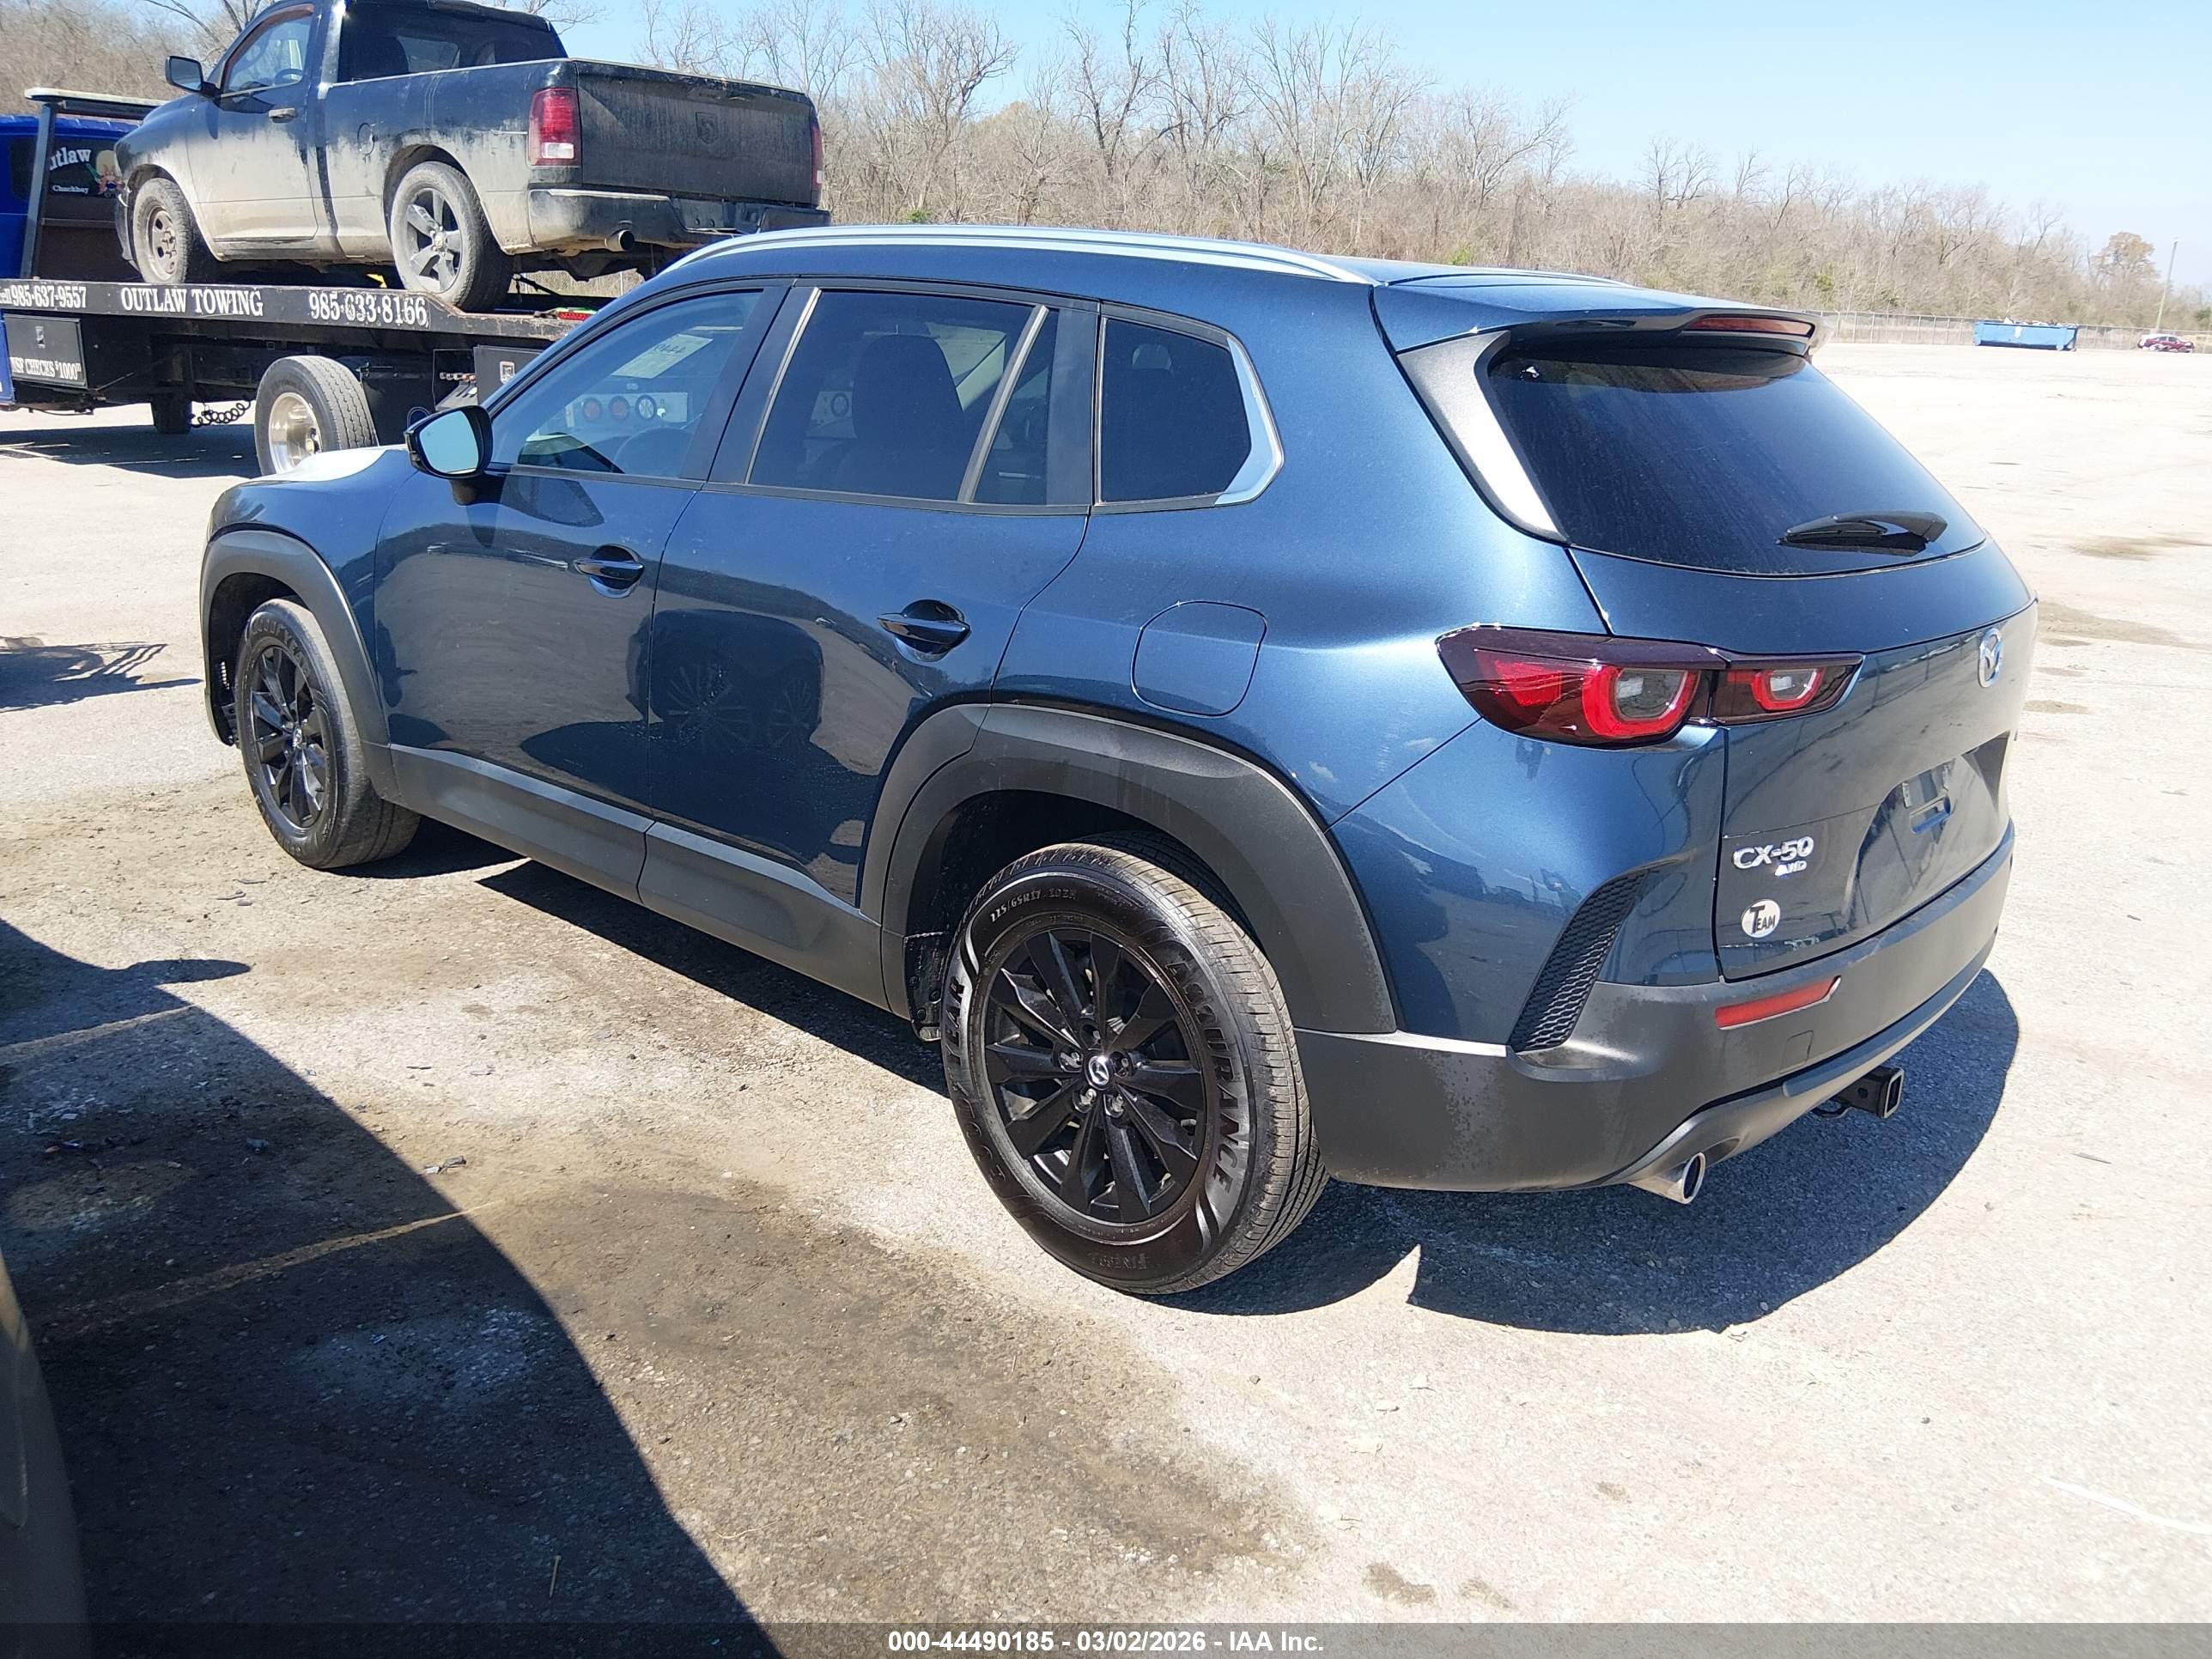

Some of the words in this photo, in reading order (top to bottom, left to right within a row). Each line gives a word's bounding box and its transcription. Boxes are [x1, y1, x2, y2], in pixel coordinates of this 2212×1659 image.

[120, 287, 188, 313] OUTLAW
[191, 288, 264, 318] TOWING
[25, 358, 56, 378] CHECKS
[1732, 836, 1814, 869] CX-50
